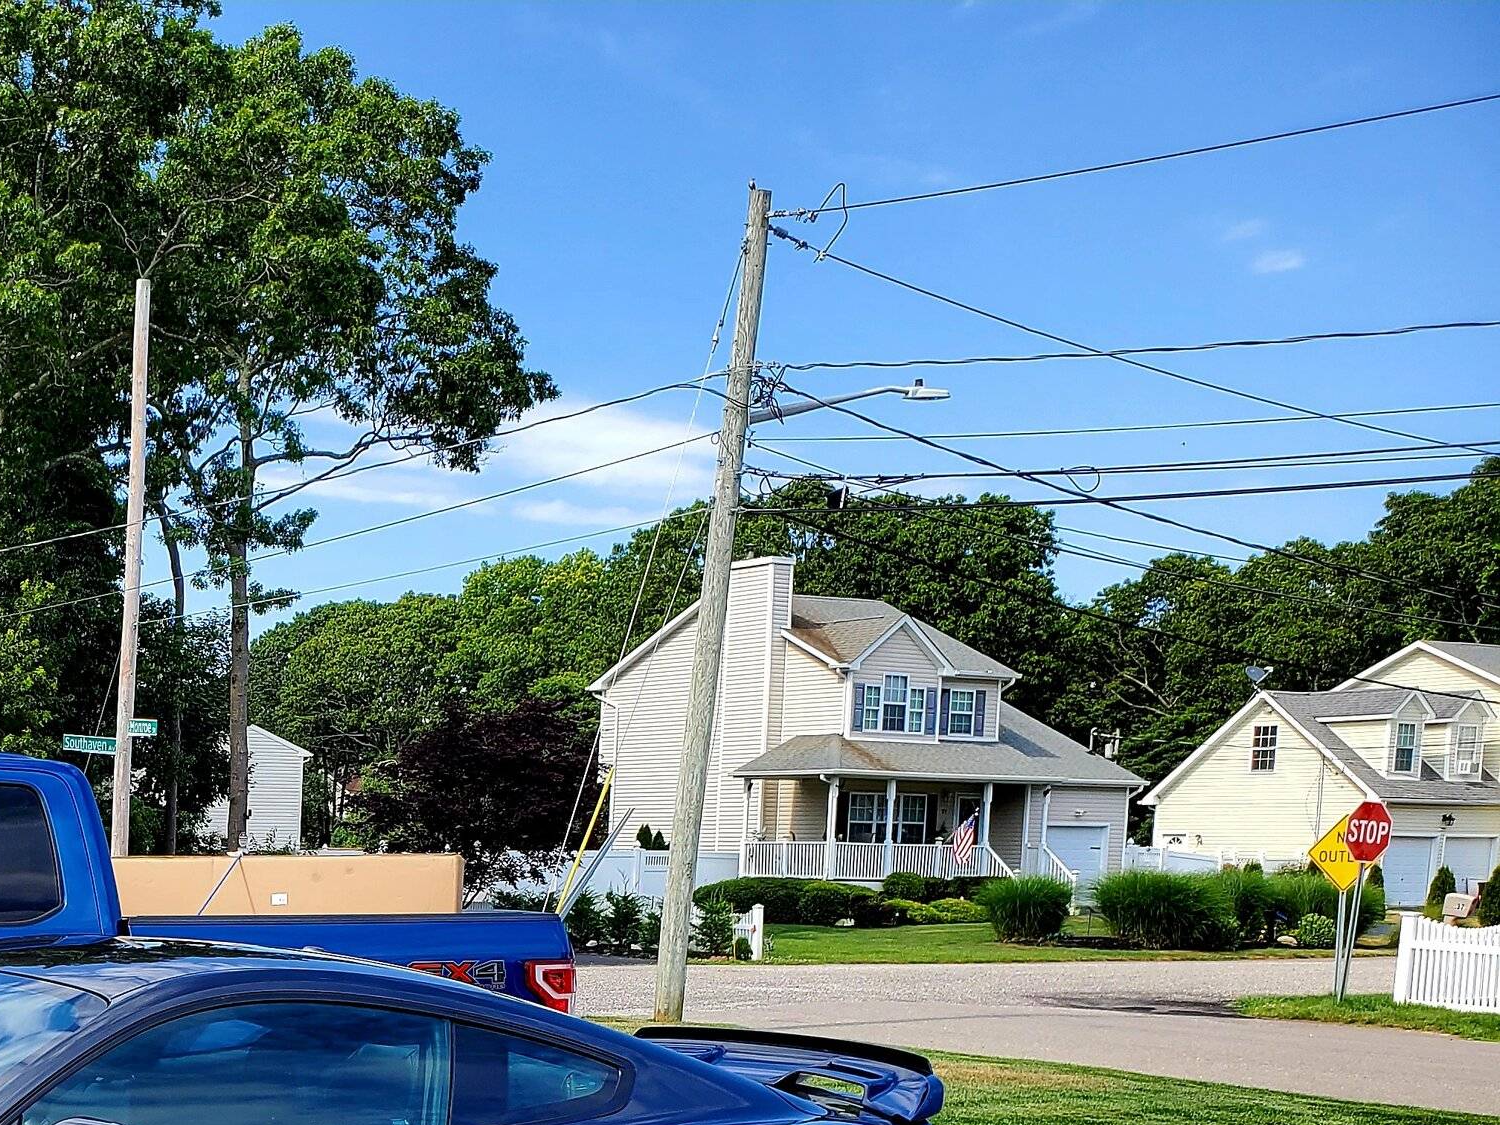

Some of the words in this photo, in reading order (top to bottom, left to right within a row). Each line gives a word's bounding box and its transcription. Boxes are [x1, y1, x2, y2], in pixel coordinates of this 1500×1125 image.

[130, 721, 151, 733] Monroe
[64, 736, 107, 751] Southaven
[1348, 818, 1389, 844] STOP
[1319, 850, 1354, 862] OUTL
